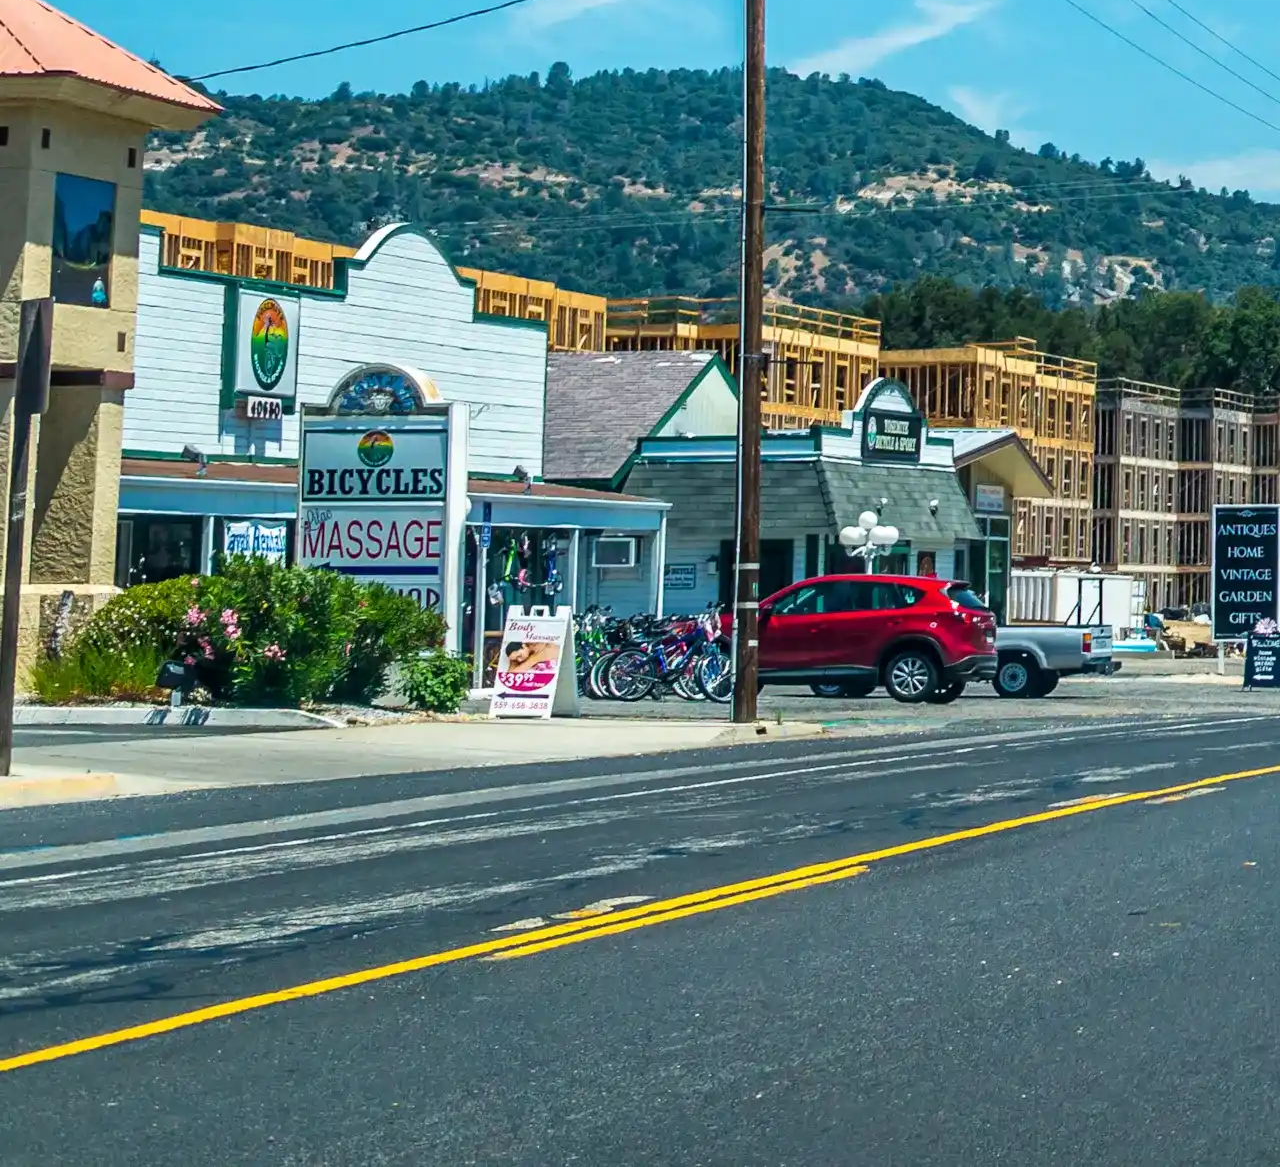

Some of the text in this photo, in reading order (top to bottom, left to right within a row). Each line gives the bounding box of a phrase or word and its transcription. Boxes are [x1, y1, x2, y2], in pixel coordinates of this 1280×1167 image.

[306, 468, 444, 496] BICYCLES
[1218, 524, 1276, 538] ANTIQUES
[302, 519, 443, 559] MASSAGE
[1227, 546, 1265, 559] HOME
[1220, 568, 1273, 581] VINTAGE
[1219, 590, 1272, 603] GARDEN
[1229, 612, 1262, 625] GIFTS
[508, 621, 536, 632] Body
[524, 633, 561, 642] Massage
